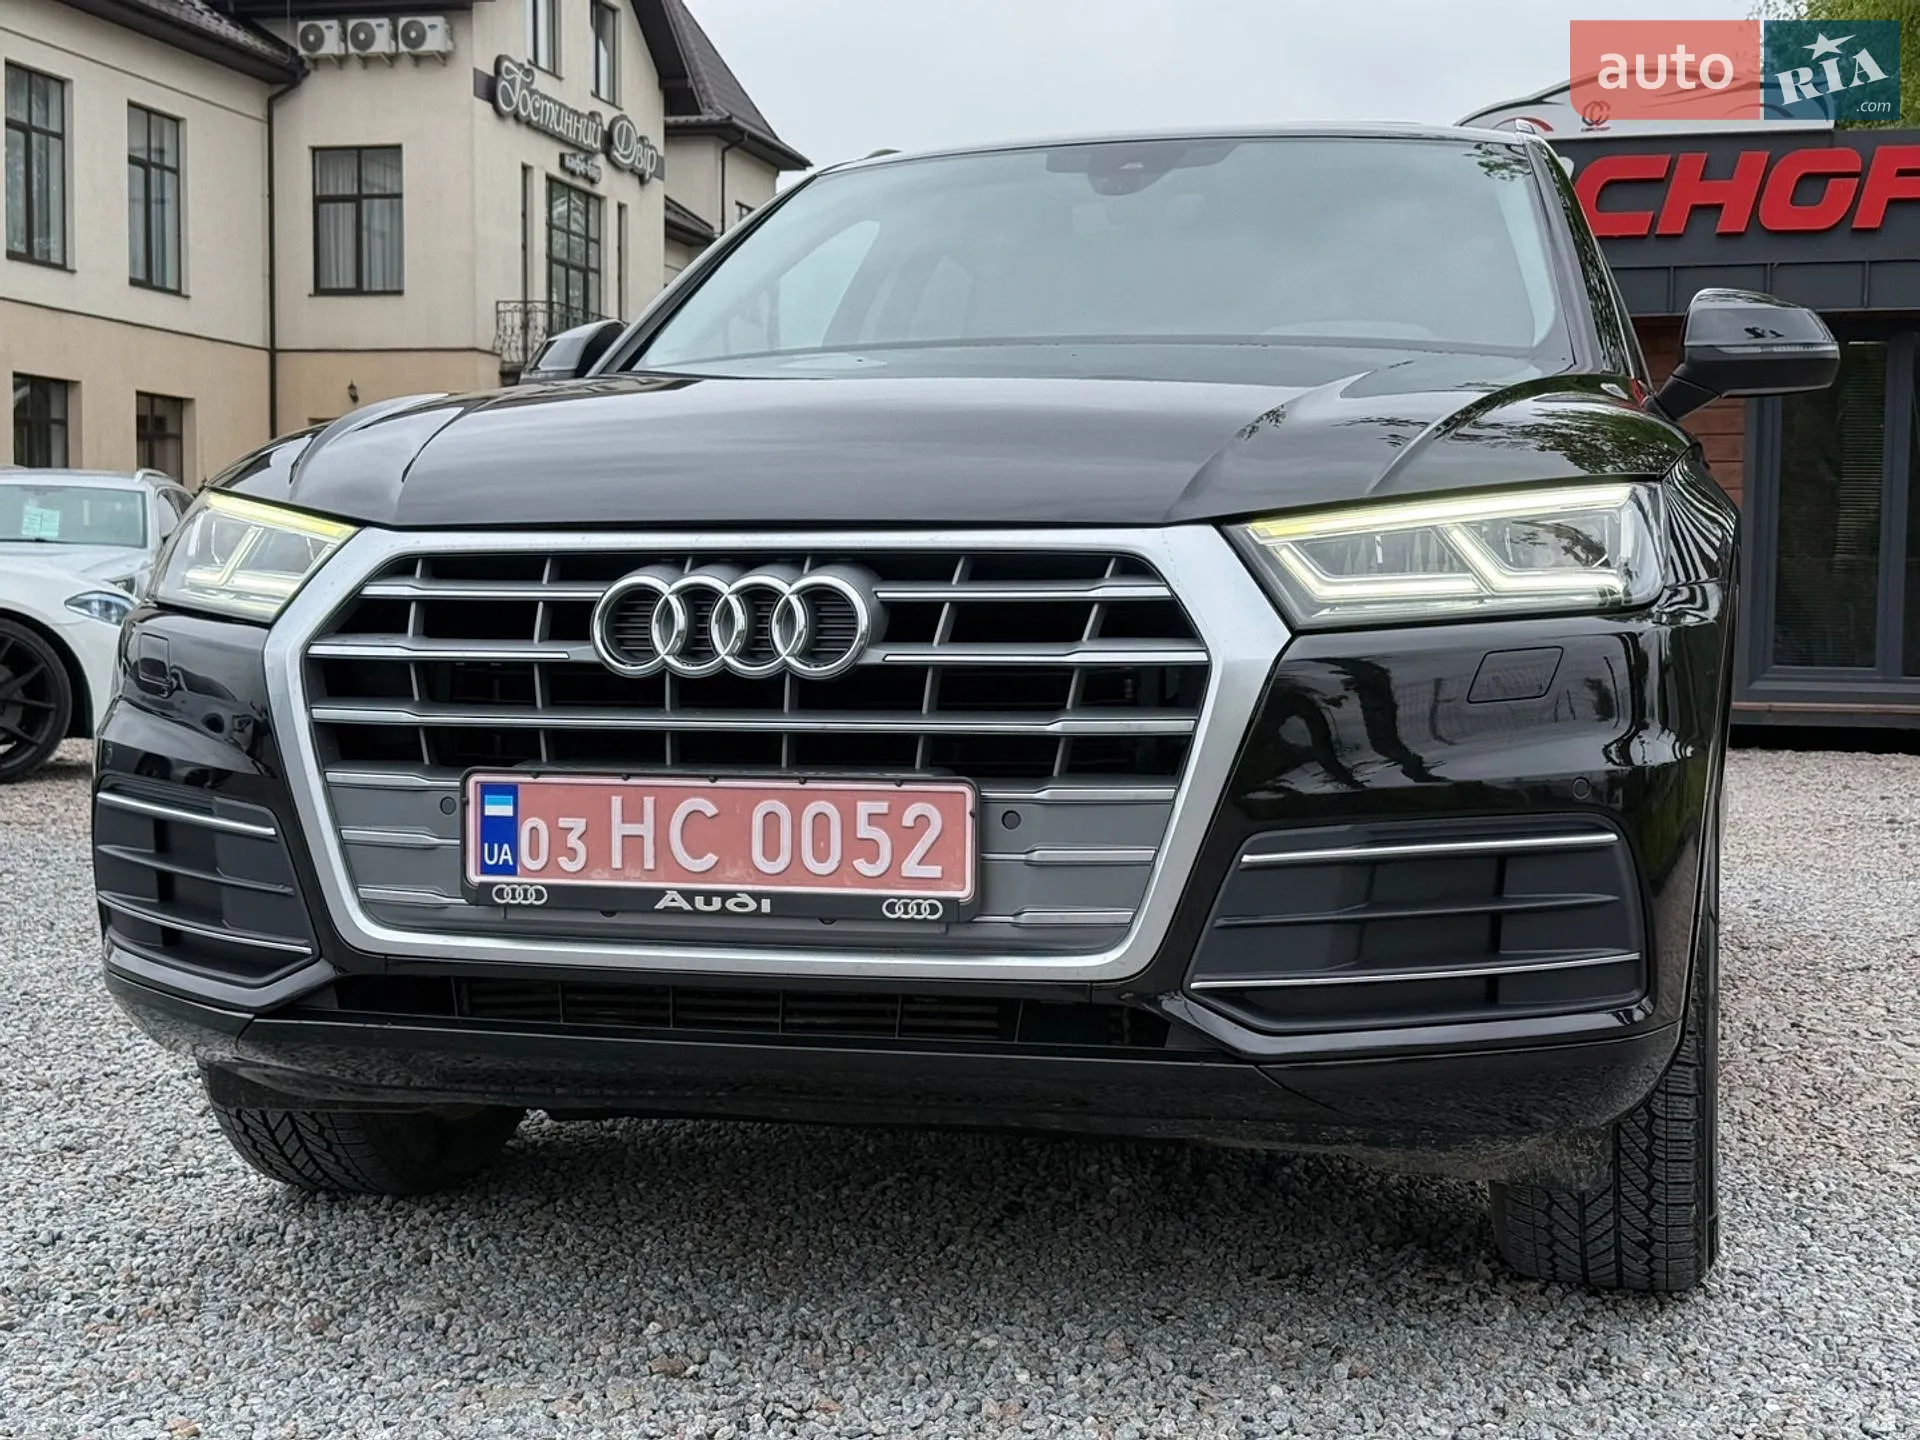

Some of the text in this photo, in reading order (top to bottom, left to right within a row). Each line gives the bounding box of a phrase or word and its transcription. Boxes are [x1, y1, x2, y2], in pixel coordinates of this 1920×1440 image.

[497, 60, 658, 178] Гостинний Двір
[484, 796, 943, 879] UA 03 HC 0052
[654, 890, 772, 914] Audi
